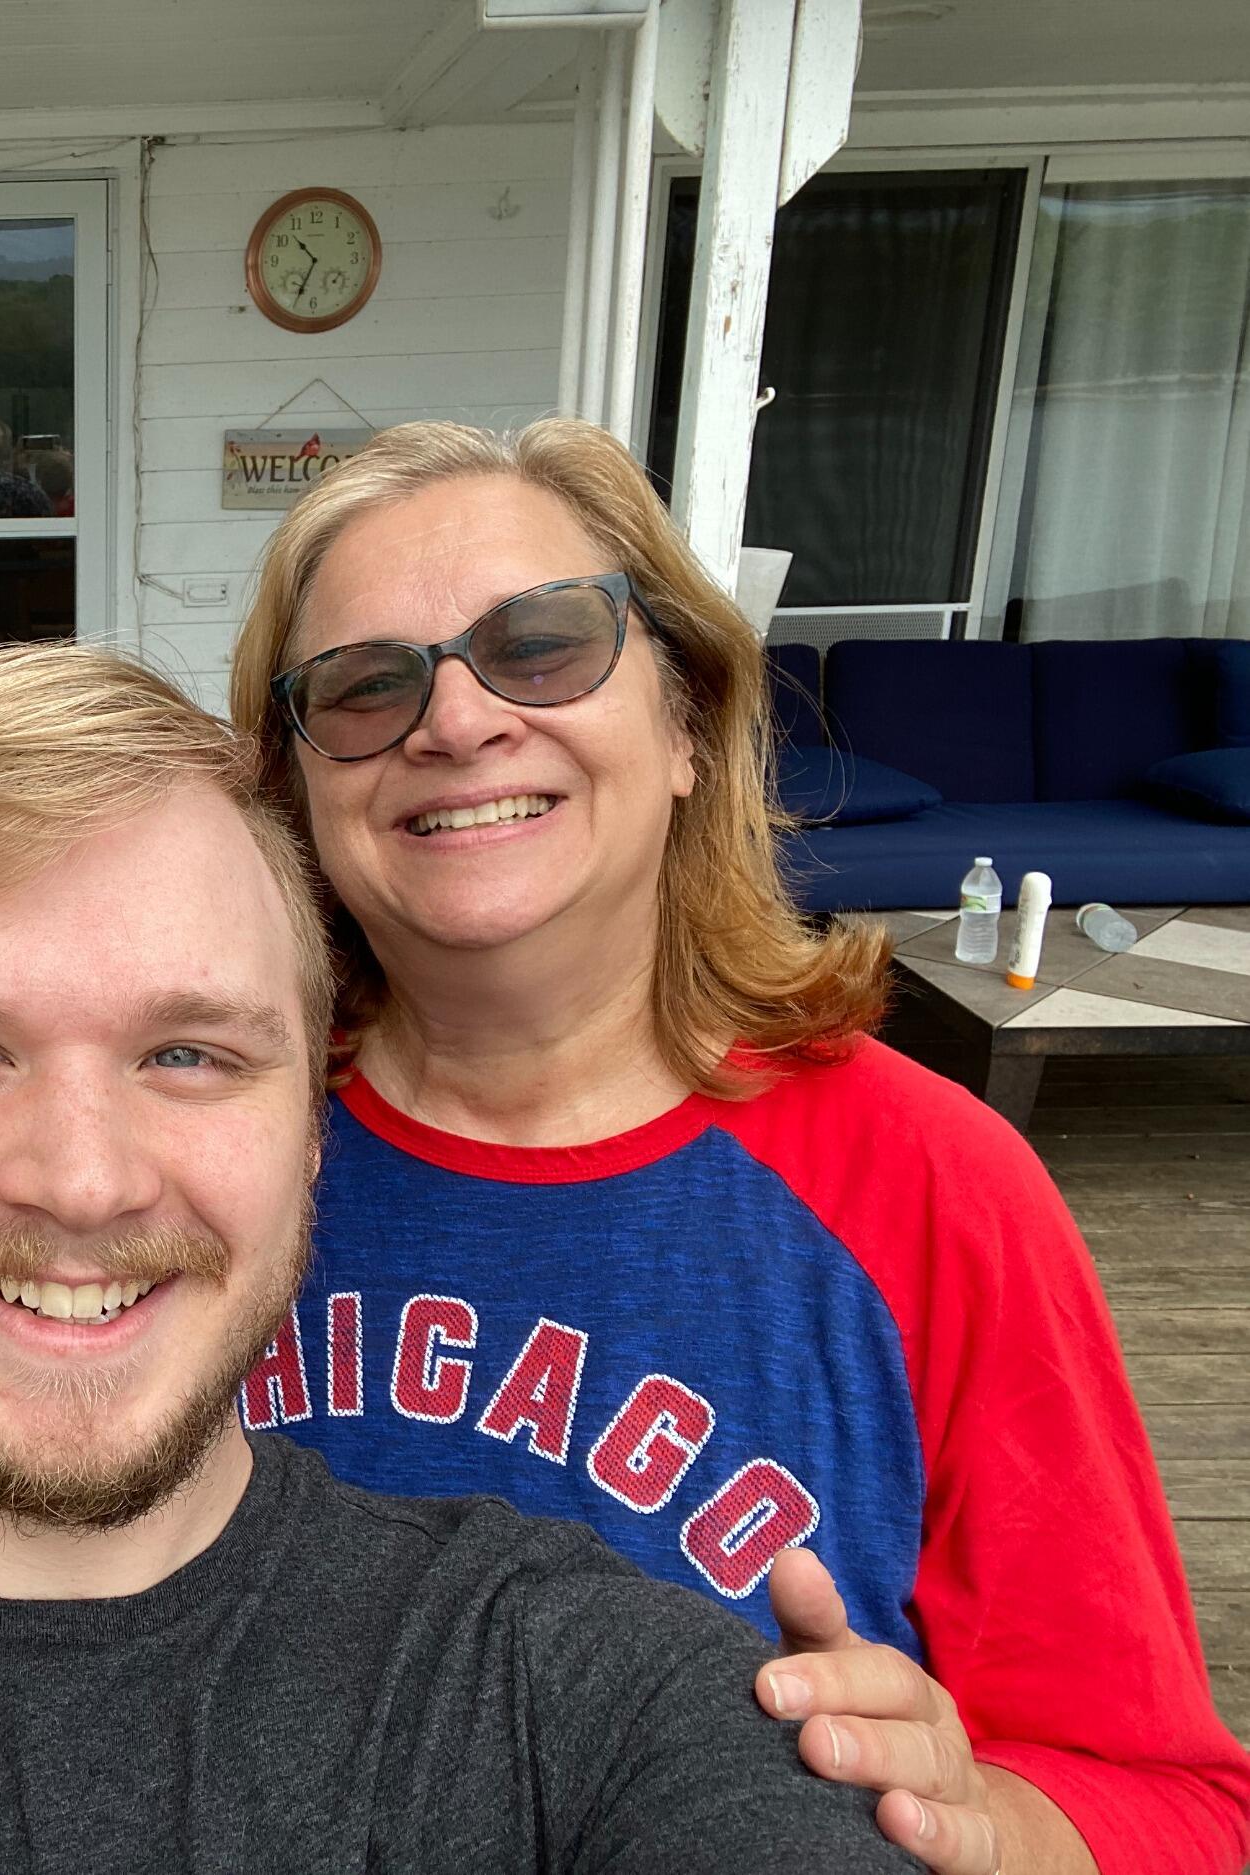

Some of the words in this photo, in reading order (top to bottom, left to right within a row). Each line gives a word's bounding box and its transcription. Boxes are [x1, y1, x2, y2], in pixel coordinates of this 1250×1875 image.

[290, 217, 302, 231] 11
[309, 211, 323, 224] 12
[334, 215, 340, 229] 1
[276, 234, 289, 248] 10
[346, 231, 356, 245] 2
[270, 255, 279, 267] 9
[350, 251, 359, 264] 3
[309, 296, 318, 310] 6
[240, 455, 353, 482] WELCO
[241, 1291, 821, 1600] HICAGO
